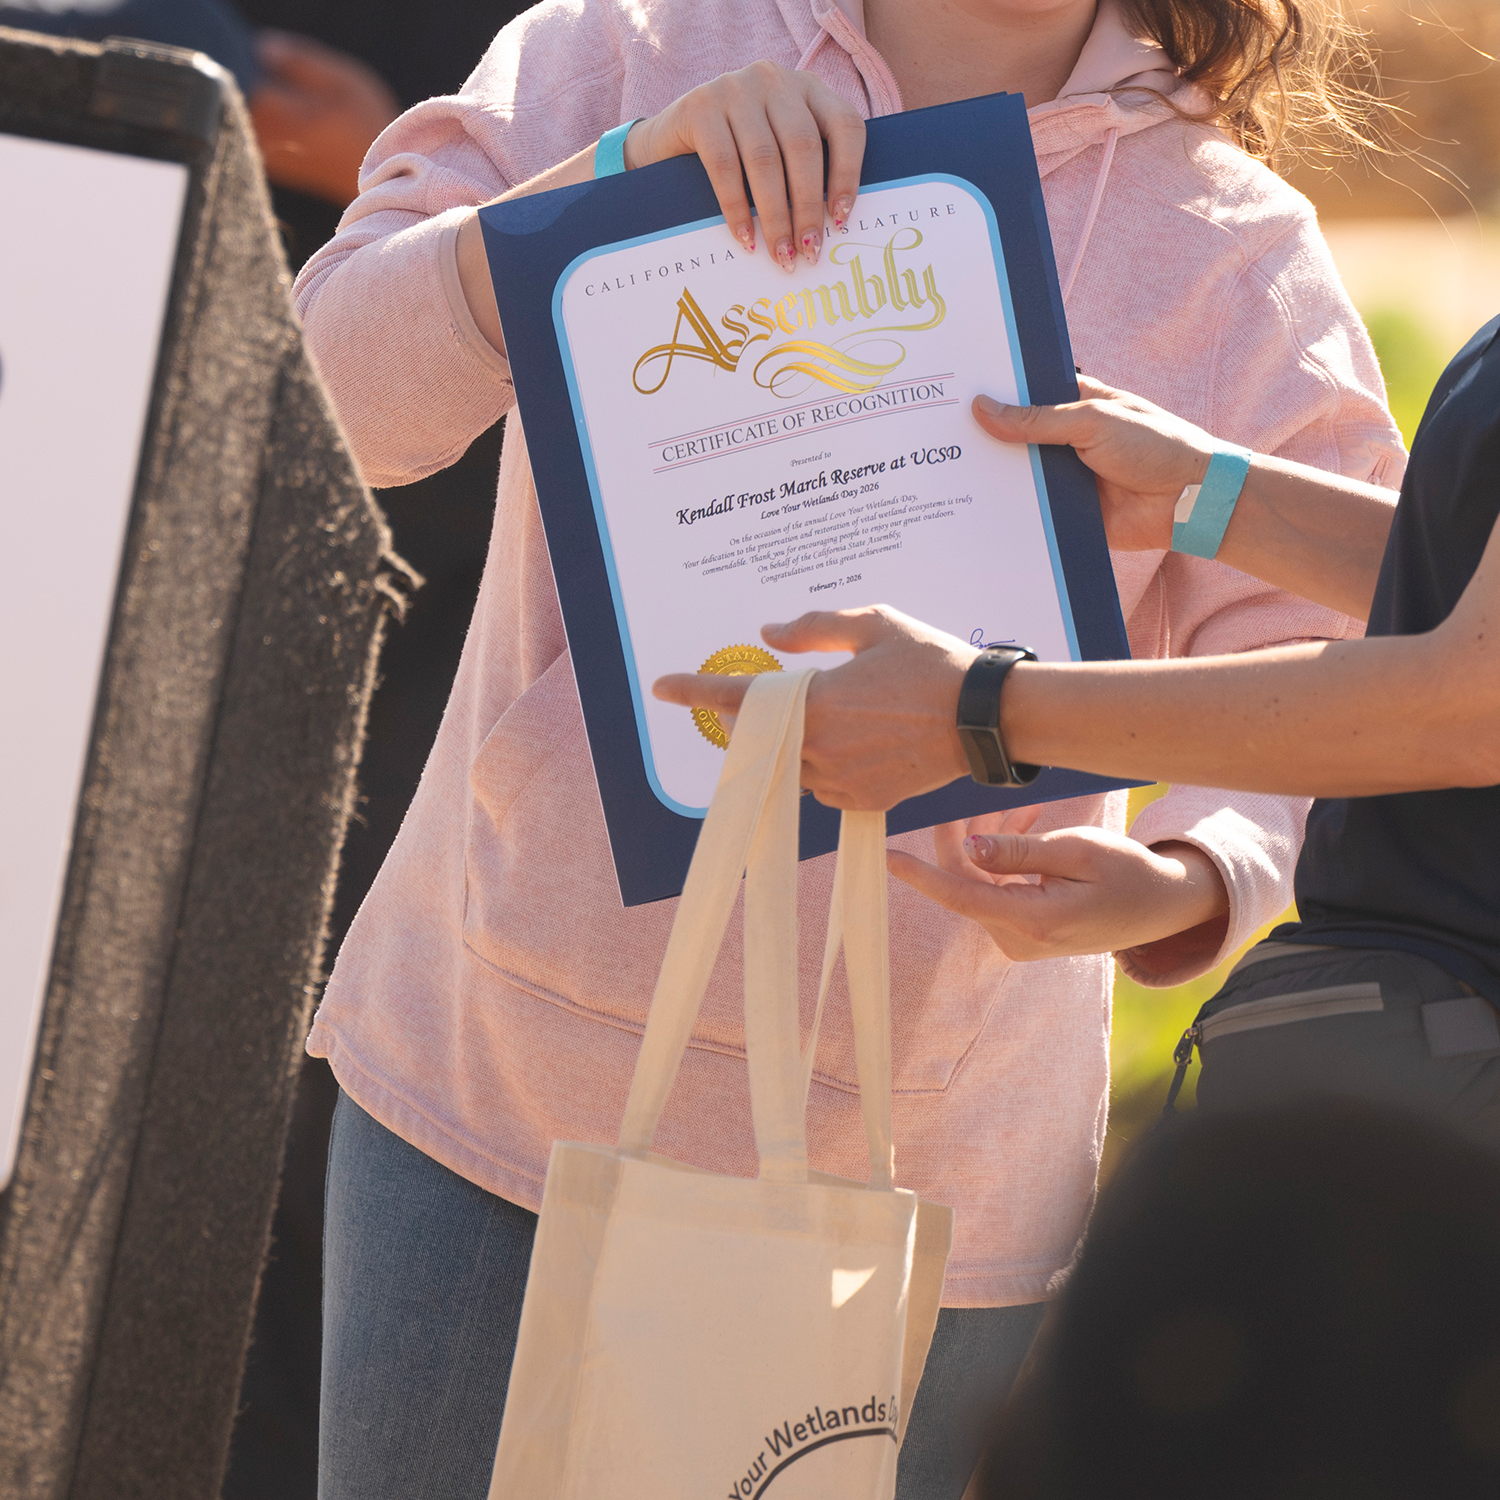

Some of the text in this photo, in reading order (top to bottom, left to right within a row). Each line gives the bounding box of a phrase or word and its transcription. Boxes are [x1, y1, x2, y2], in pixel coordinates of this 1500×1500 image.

[585, 204, 955, 295] CALIFORNIA ISLATURE
[633, 227, 947, 397] Assembly
[662, 383, 943, 461] CERTIFICATE OF RECOGNITION
[676, 445, 961, 524] Kendall Frost March Reserve at UCSD
[790, 451, 822, 466] Presented
[682, 560, 699, 568] Your
[701, 551, 734, 564] dedication
[745, 544, 755, 553] the
[757, 535, 798, 552] preservation
[800, 528, 813, 539] and
[814, 521, 849, 535] restoration
[851, 516, 859, 527] of
[860, 511, 877, 523] vital
[878, 504, 907, 518] wetland
[908, 500, 945, 512] ecosystems
[955, 494, 972, 504] truly
[742, 534, 752, 542] the
[754, 528, 781, 539] occasion
[783, 522, 791, 534] of
[792, 520, 802, 529] the
[804, 513, 828, 526] annual
[829, 511, 845, 520] Love
[847, 506, 864, 514] Your
[865, 496, 898, 509] Wetlands
[761, 481, 879, 519] Love Your Wetlands Day 2026
[702, 557, 747, 575] commendable.
[749, 551, 773, 562] Thank
[772, 550, 784, 560] you
[785, 545, 796, 556] for
[798, 536, 837, 550] encouraging
[839, 528, 859, 542] people
[870, 523, 888, 532] enjoy
[903, 515, 920, 526] great
[923, 509, 954, 520] outdoors.
[760, 565, 813, 584] Congratulations
[826, 557, 838, 566] this
[839, 553, 856, 565] great
[858, 541, 901, 557] achievement!
[770, 556, 791, 569] behalf
[792, 554, 799, 566] of
[801, 552, 811, 561] the
[812, 545, 846, 559] California
[847, 540, 865, 549] State
[809, 582, 836, 592] February
[846, 573, 861, 583] 2026
[728, 1451, 768, 1500] Your
[764, 1394, 887, 1458] Wetlands
